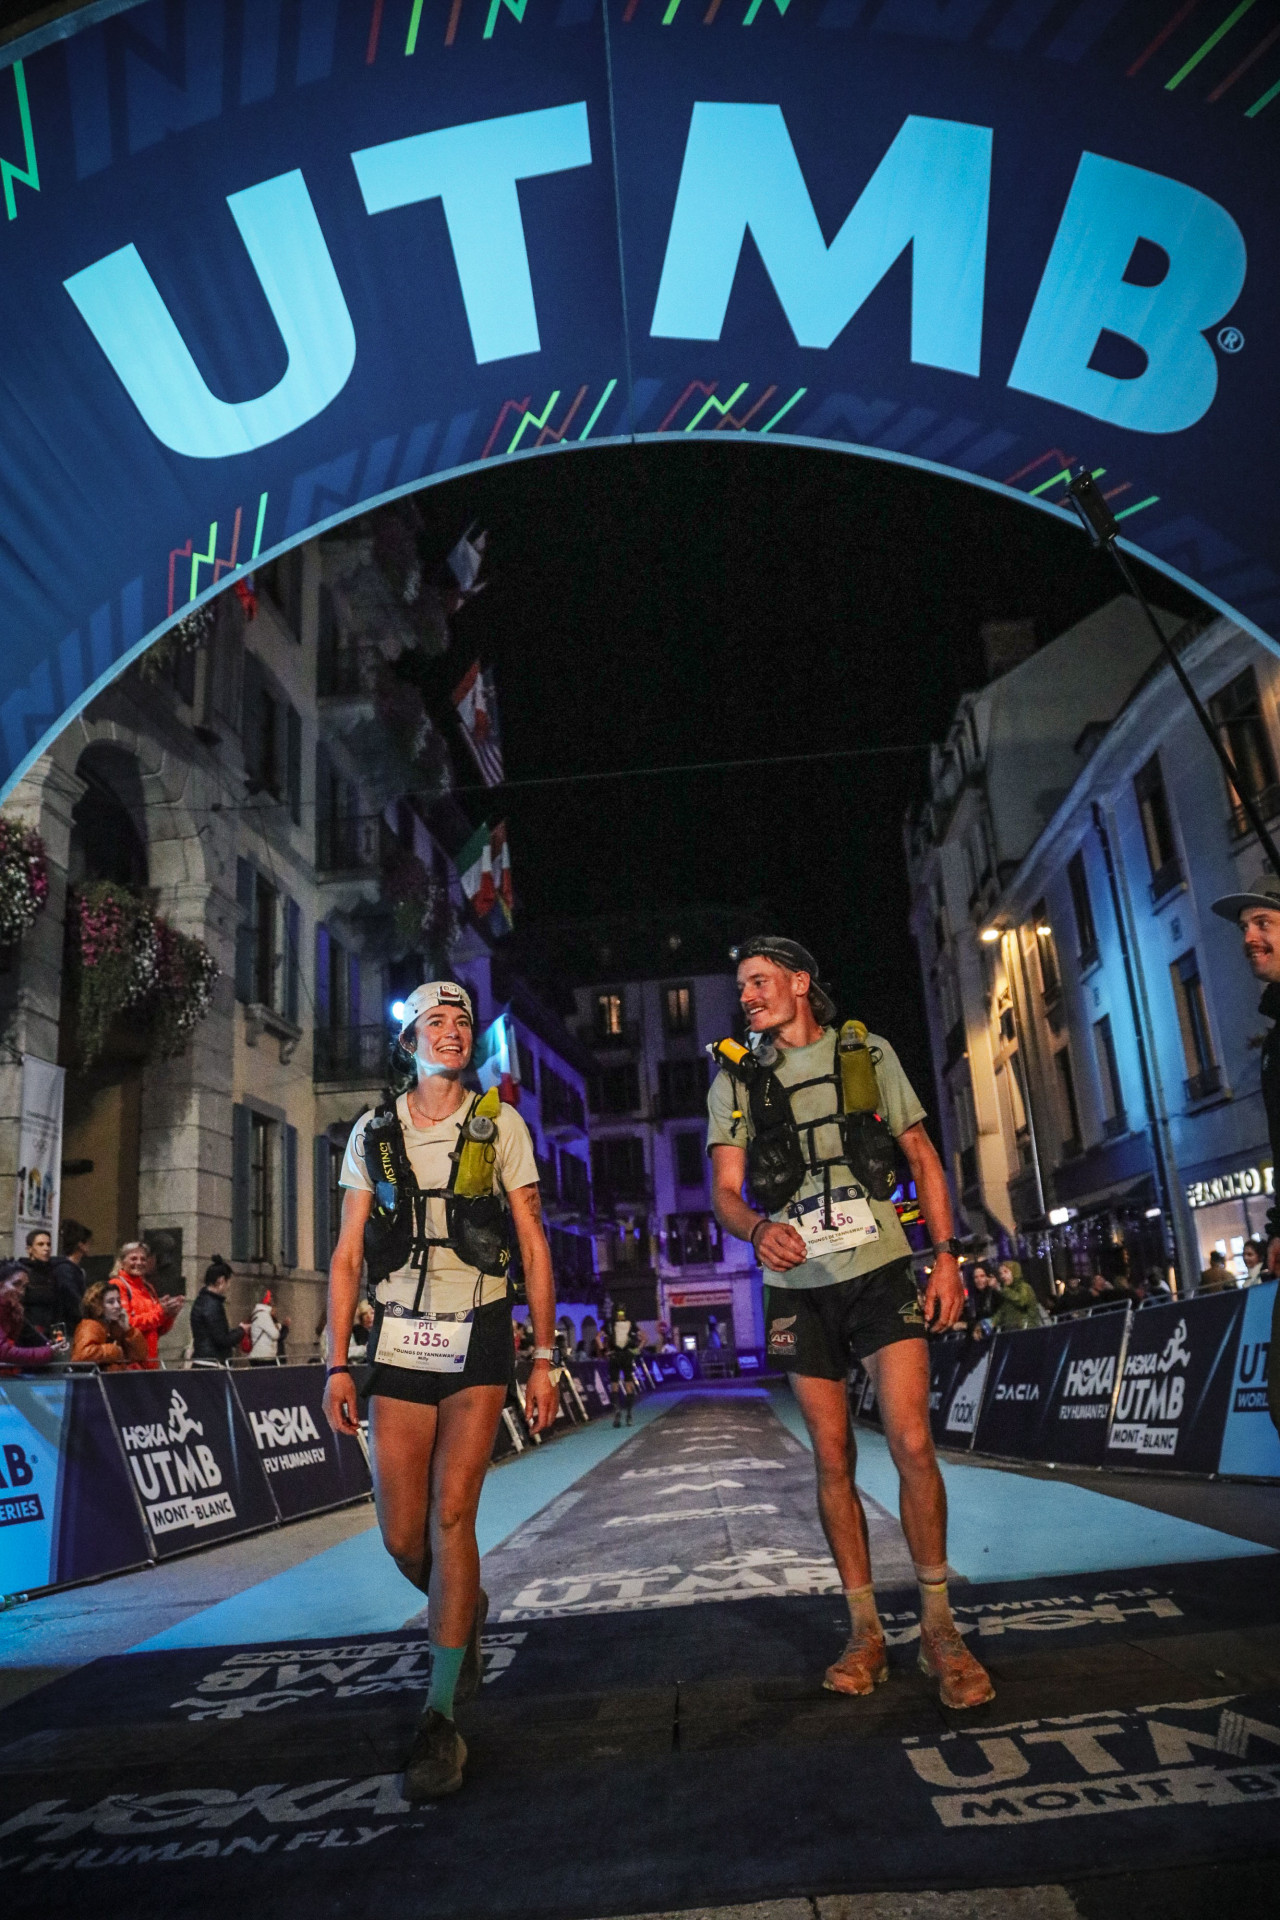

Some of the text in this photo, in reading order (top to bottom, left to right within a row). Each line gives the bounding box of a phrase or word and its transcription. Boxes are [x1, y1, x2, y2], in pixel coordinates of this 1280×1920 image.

[63, 101, 1248, 459] UTMB
[418, 1322, 434, 1330] PTL
[771, 1334, 795, 1344] AFL
[1063, 1356, 1116, 1397] HOKA
[1124, 1353, 1157, 1376] HOKA
[996, 1384, 1040, 1400] DACIA
[1116, 1375, 1186, 1420] UTMB
[1059, 1404, 1072, 1419] FLY
[1071, 1404, 1098, 1419] HUMAN
[121, 1423, 169, 1450] HOKA
[249, 1405, 320, 1450] HOKA
[130, 1444, 223, 1500] UTMB
[263, 1447, 326, 1473] FLY HUMAN FLY
[512, 1566, 842, 1609] UTMB
[283, 1824, 399, 1852] FLY
